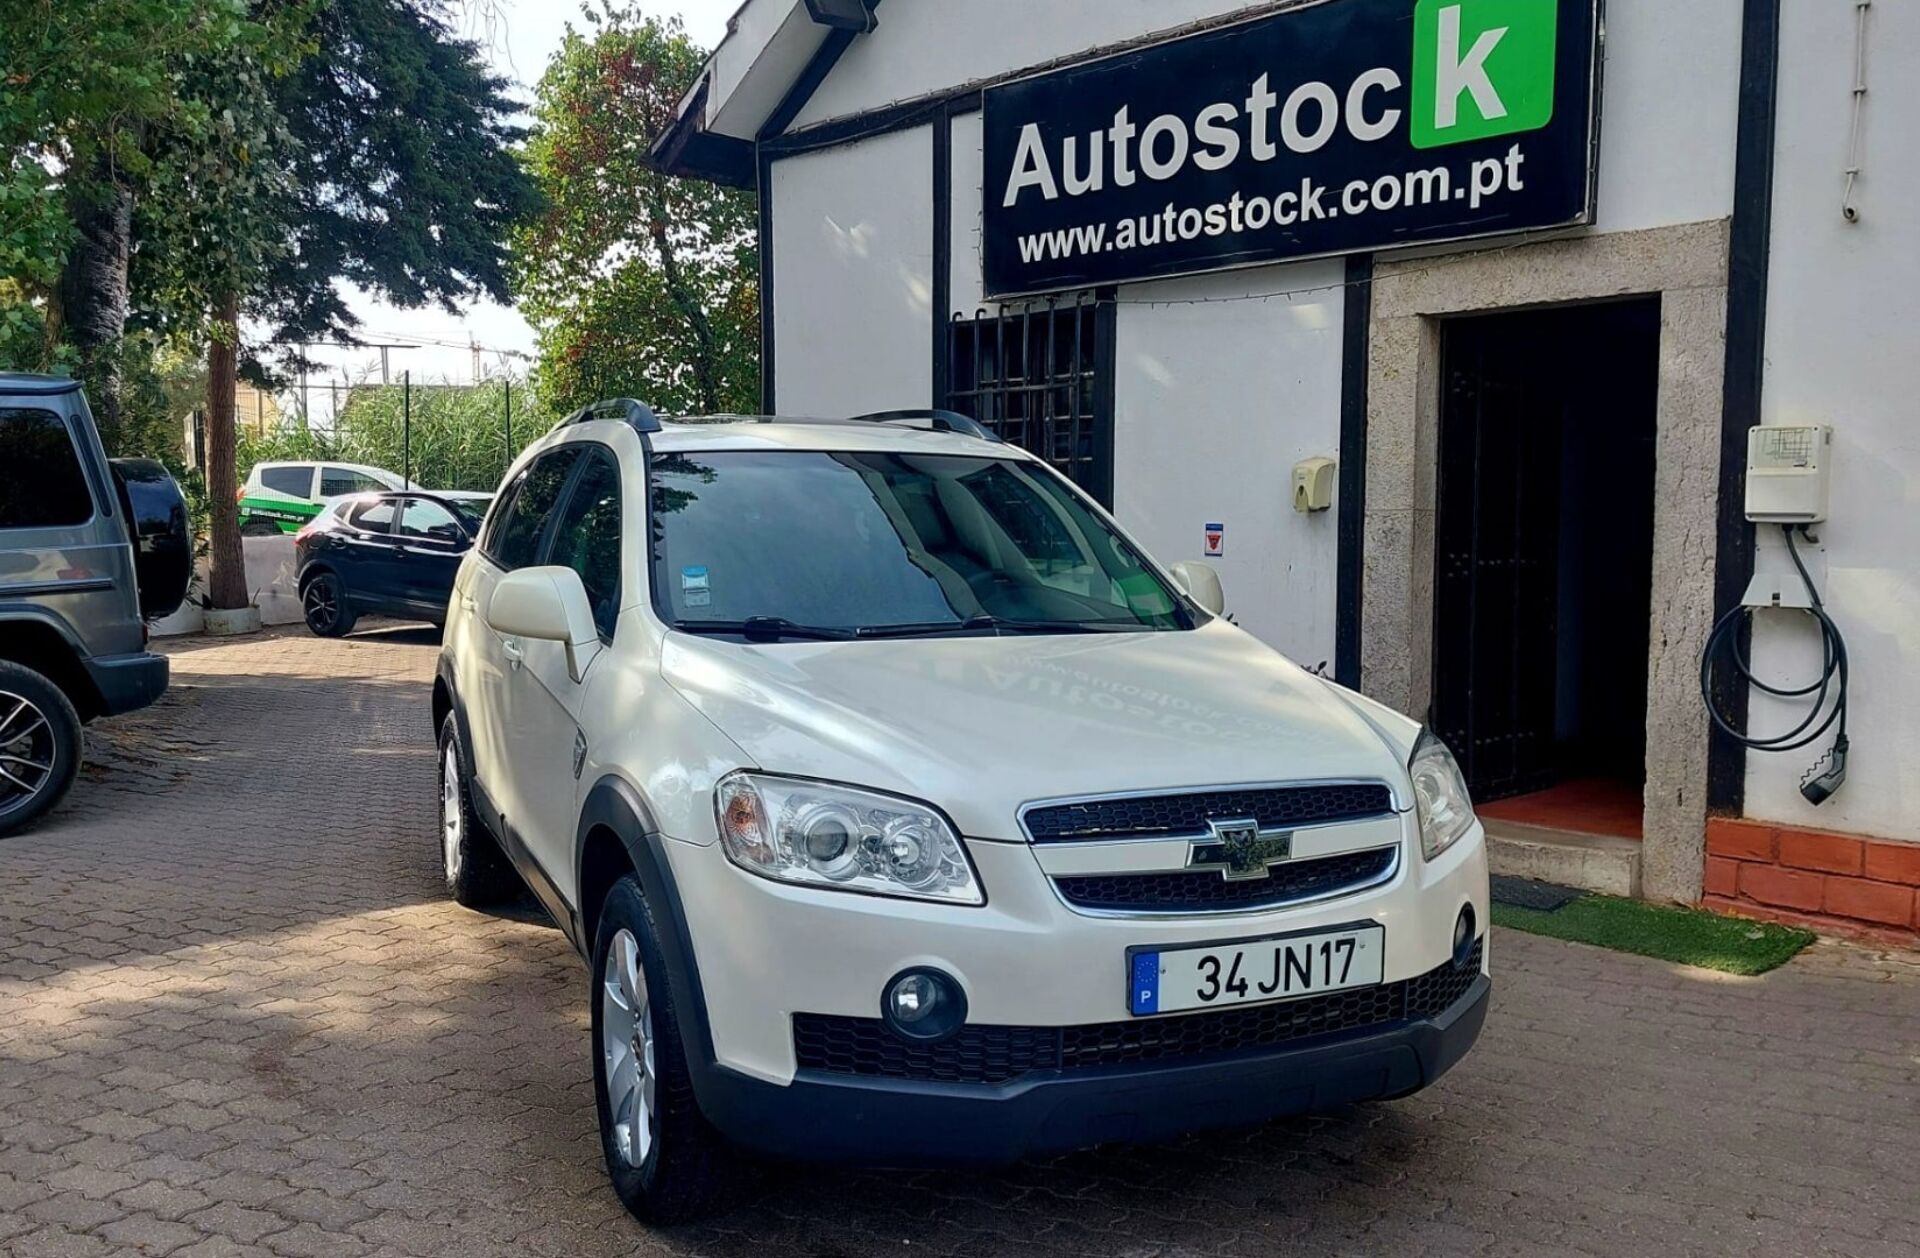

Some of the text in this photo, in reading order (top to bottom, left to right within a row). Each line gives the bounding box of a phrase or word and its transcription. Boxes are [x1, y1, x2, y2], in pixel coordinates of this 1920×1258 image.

[1003, 4, 1509, 207] Autostock
[1018, 144, 1524, 264] www.autostock.com.pt
[1141, 990, 1151, 1003] P
